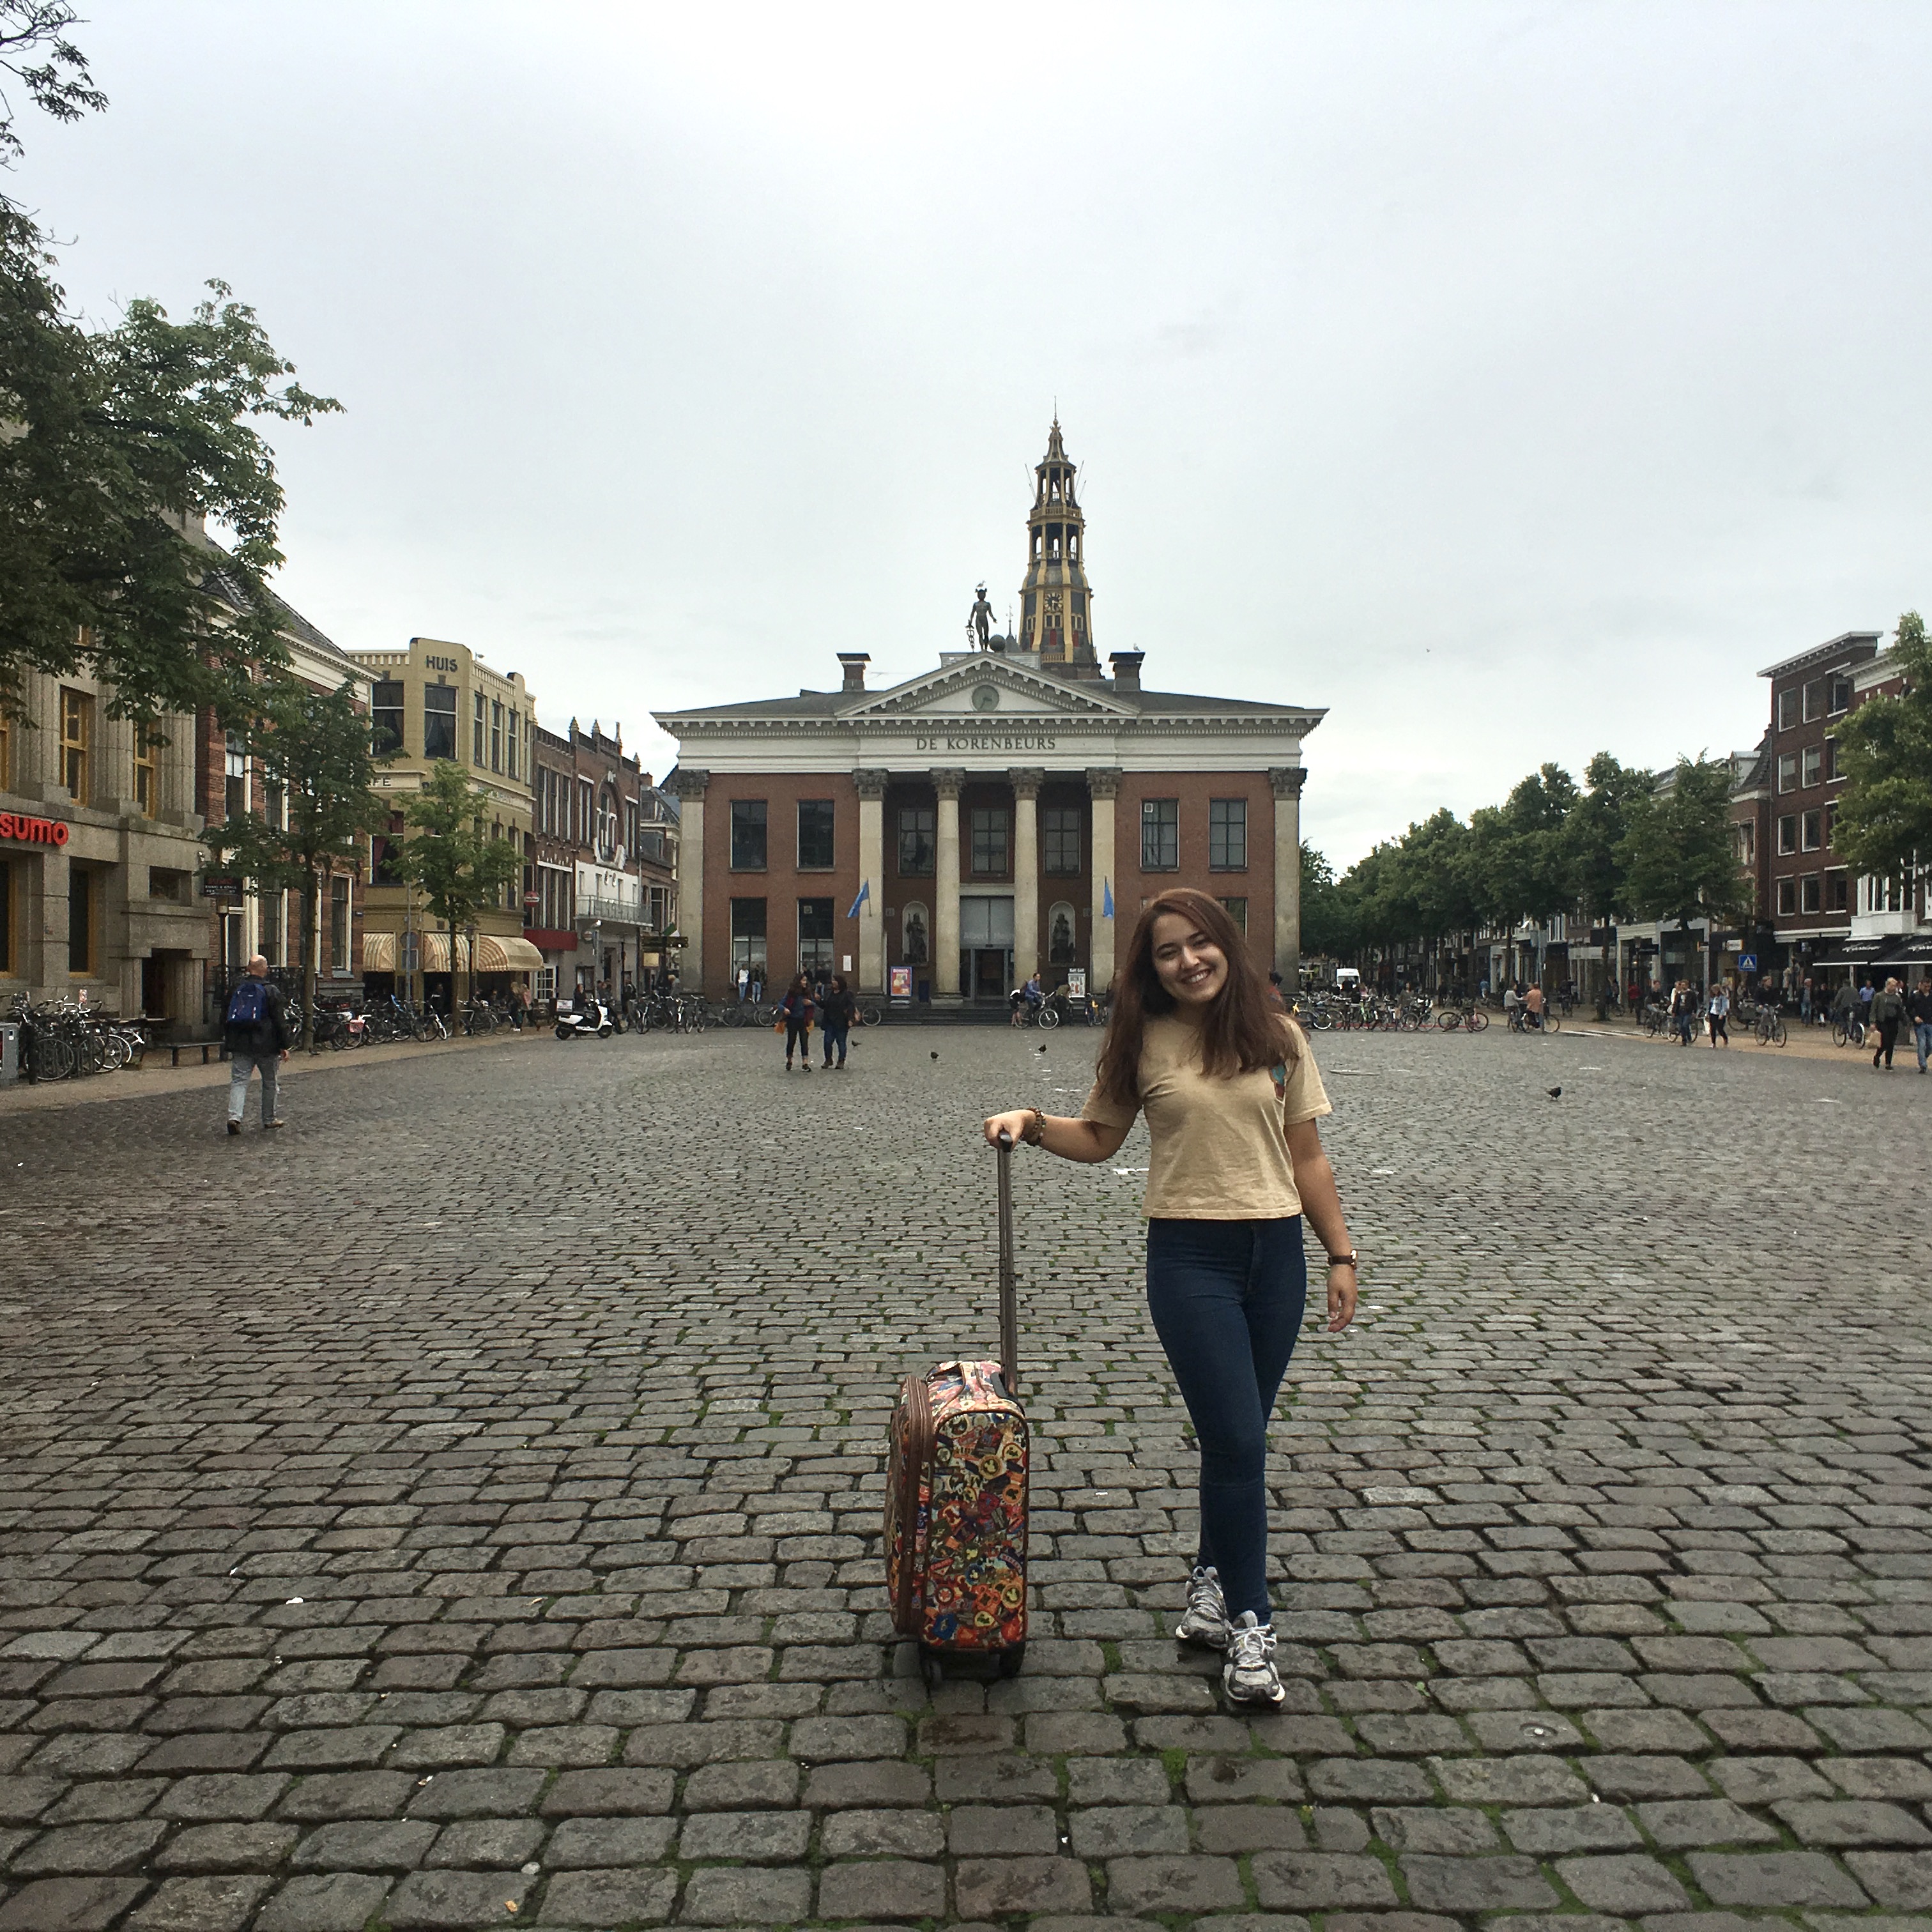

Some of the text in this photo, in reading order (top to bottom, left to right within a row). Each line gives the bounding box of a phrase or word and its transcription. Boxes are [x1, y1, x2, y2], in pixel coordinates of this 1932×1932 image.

[426, 655, 458, 672] HUIS
[916, 737, 1056, 751] DE KORENBEURS
